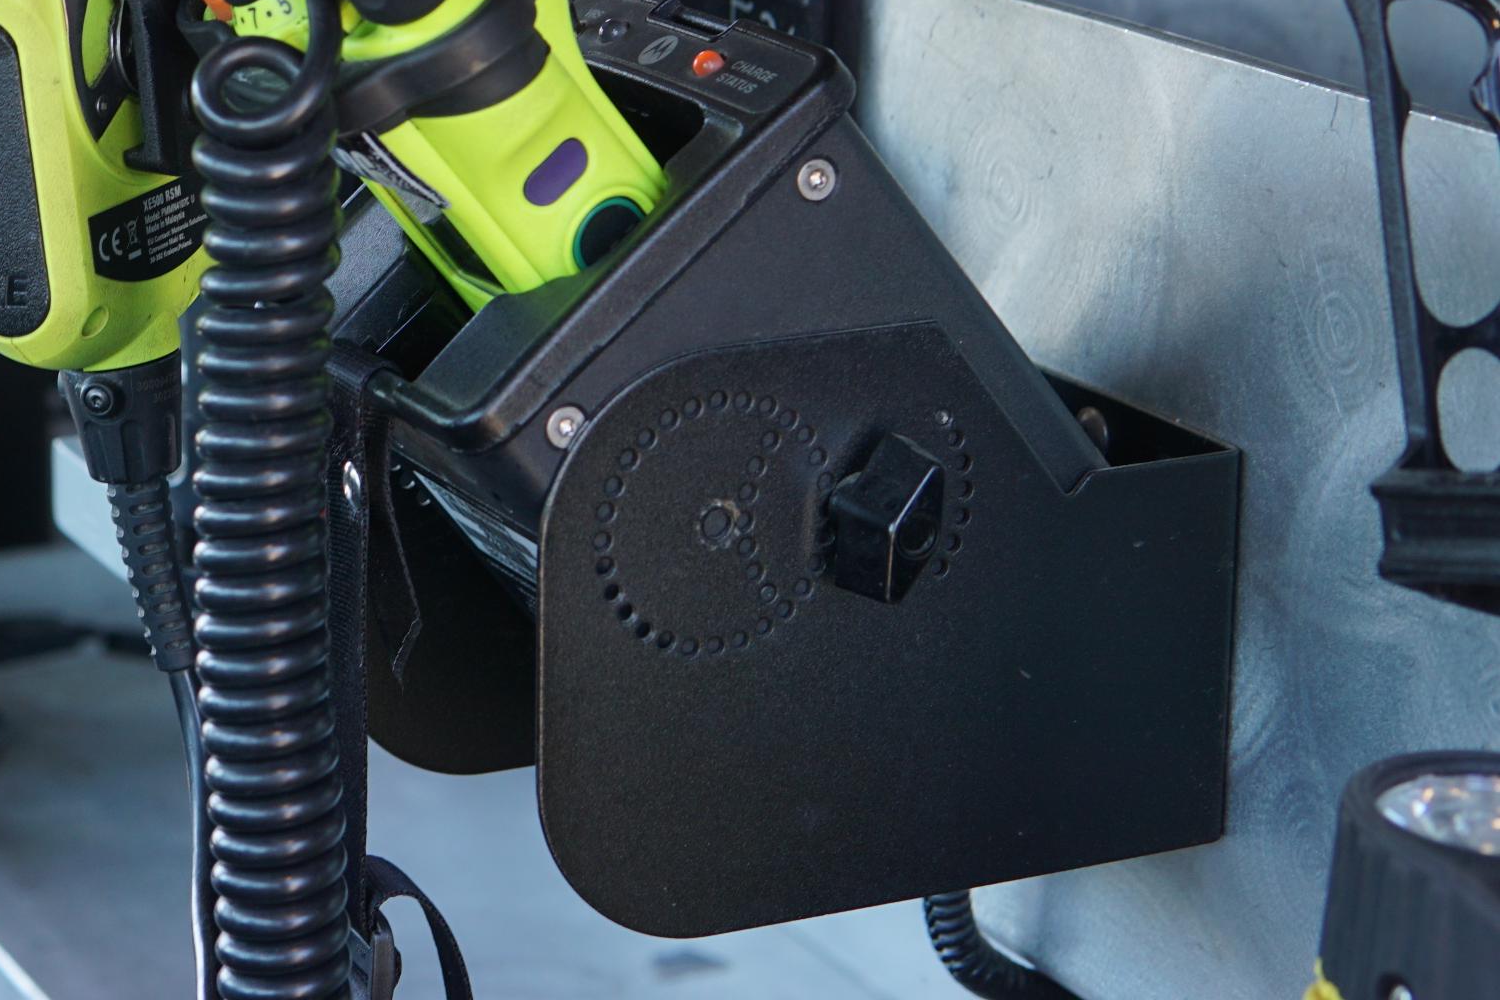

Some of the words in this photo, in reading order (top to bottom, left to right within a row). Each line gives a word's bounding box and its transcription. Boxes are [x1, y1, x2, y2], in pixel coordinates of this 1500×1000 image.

[248, 7, 258, 29] 7
[715, 72, 758, 94] STATUS
[731, 60, 778, 83] CHARGE
[143, 193, 164, 212] XE500
[165, 184, 181, 202] RSM
[146, 222, 160, 234] Made
[165, 211, 185, 226] Malaysia
